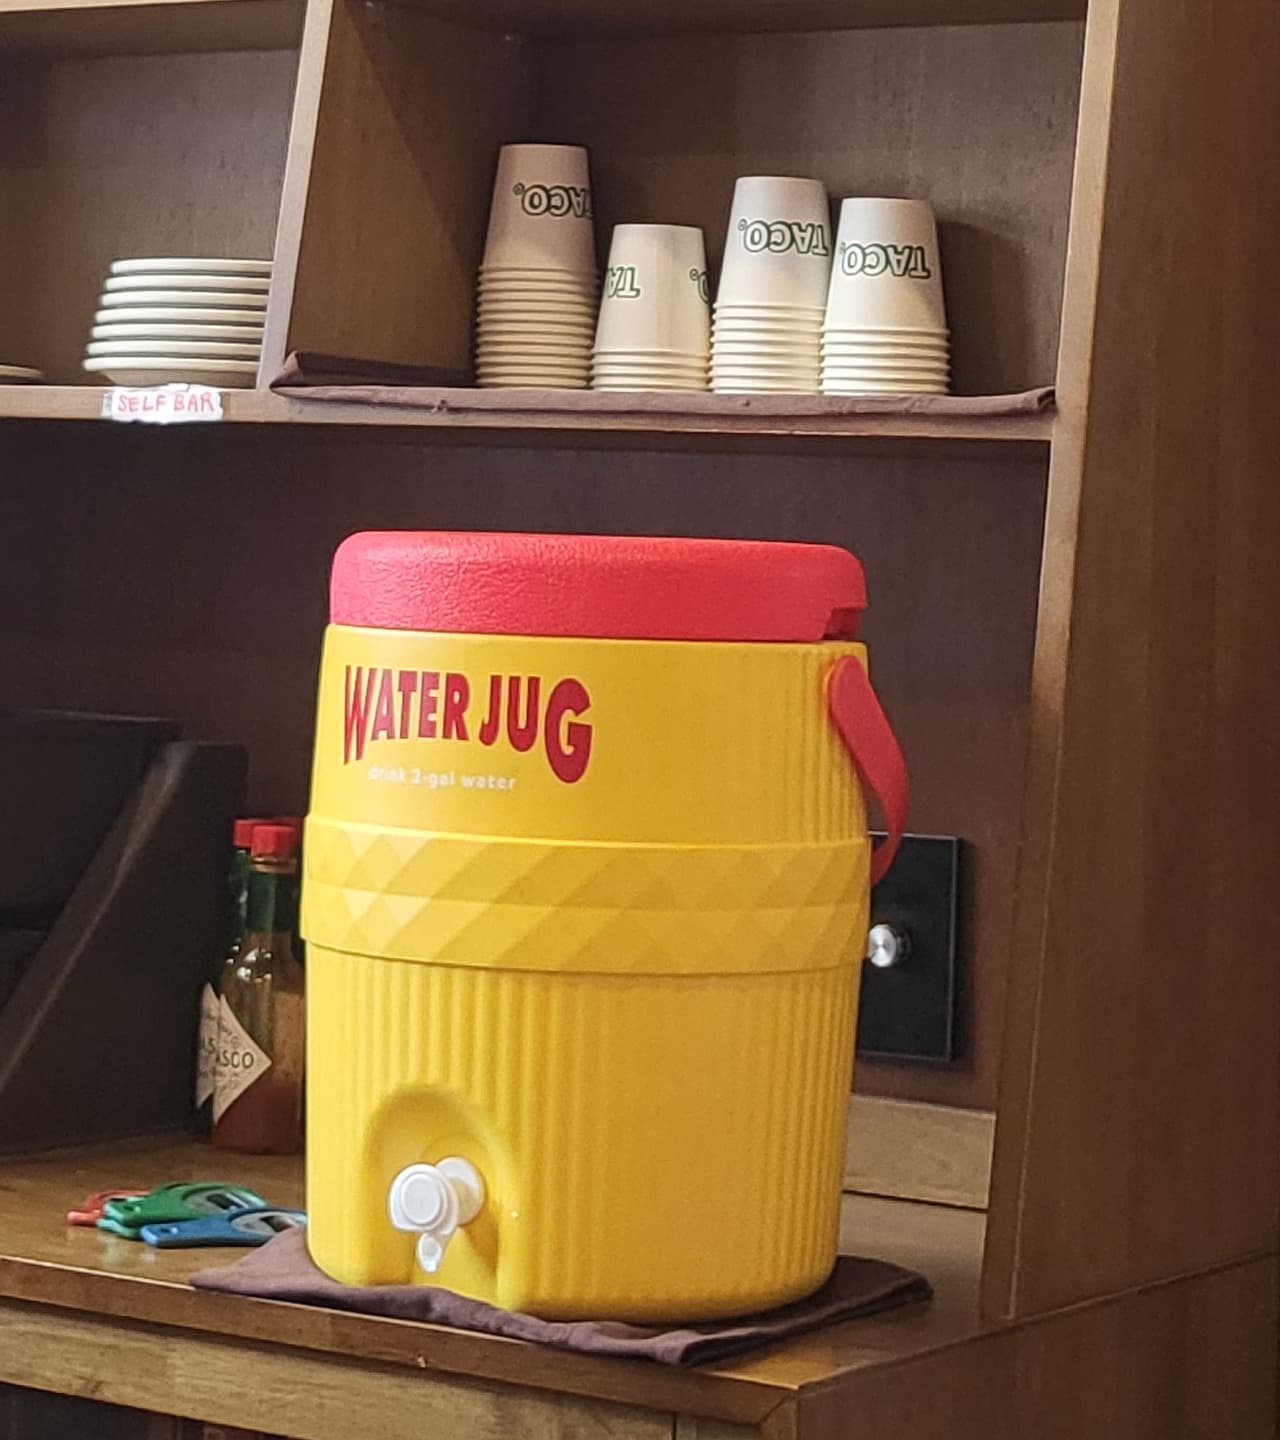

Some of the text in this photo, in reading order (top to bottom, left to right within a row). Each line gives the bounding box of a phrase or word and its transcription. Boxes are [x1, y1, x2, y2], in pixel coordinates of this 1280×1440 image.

[607, 266, 641, 299] TA
[117, 391, 214, 412] SELF BAR
[344, 664, 593, 784] WATER JUG
[461, 773, 517, 790] water
